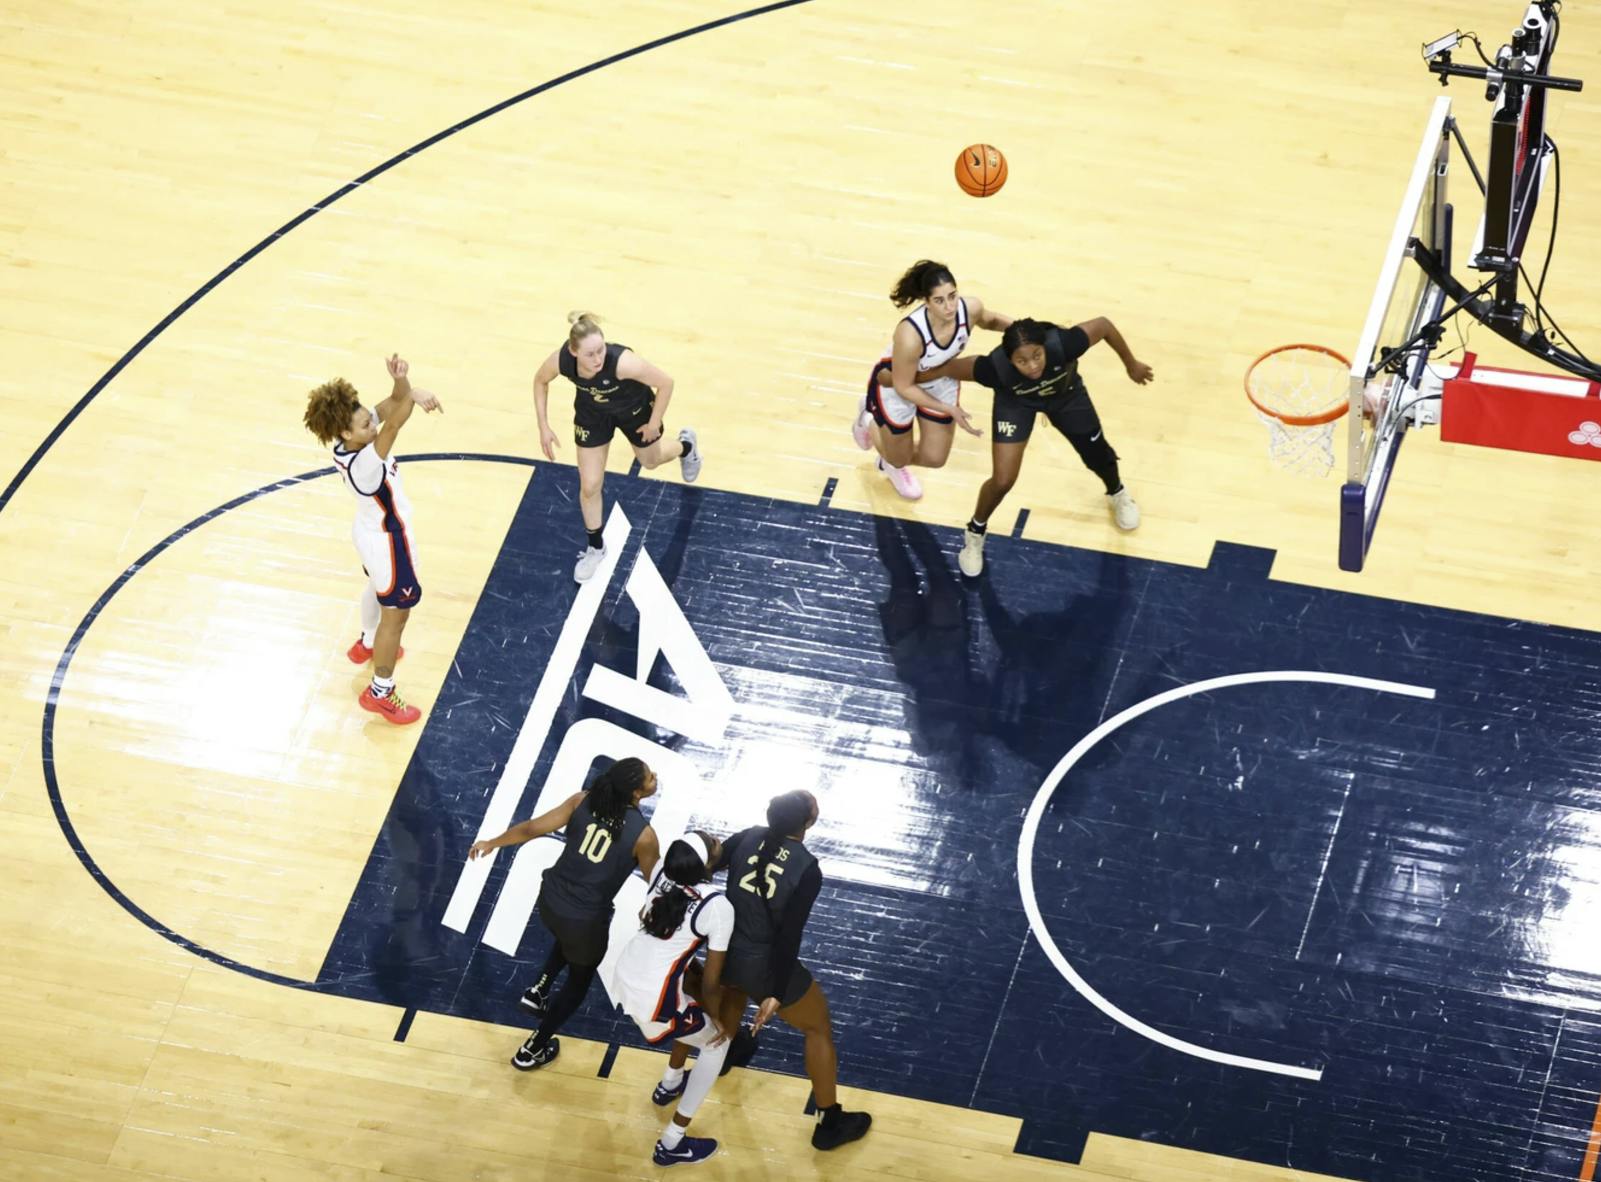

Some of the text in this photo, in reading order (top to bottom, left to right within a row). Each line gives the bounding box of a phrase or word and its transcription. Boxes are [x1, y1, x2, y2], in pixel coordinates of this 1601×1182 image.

[997, 420, 1017, 437] WF
[577, 822, 613, 864] 10
[738, 854, 785, 900] 25
